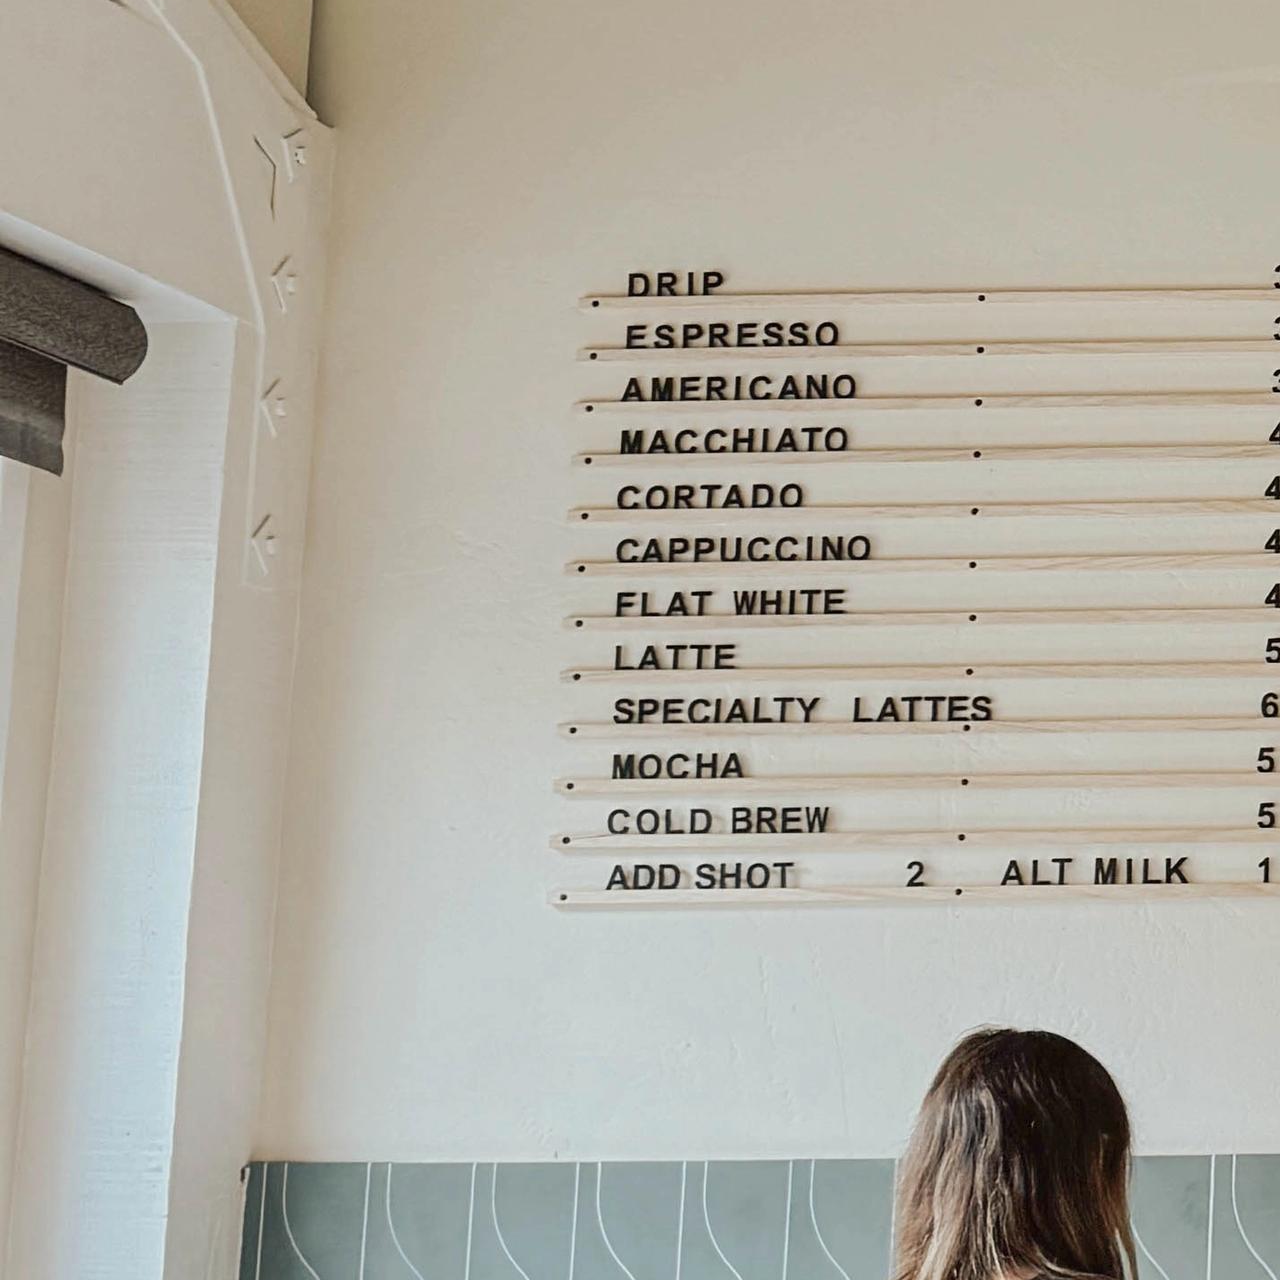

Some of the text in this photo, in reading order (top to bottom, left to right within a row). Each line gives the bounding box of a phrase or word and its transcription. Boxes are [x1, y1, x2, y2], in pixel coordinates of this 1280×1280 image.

[627, 271, 724, 298] DRIP
[624, 321, 839, 350] ESPRESSO
[619, 374, 857, 403] AMERICANO
[619, 427, 848, 455] MACCHIATO
[617, 483, 803, 510] CORTADO
[616, 535, 871, 564] CAPPUCCINO
[615, 590, 713, 618] FLAT
[733, 589, 849, 616] WHITE
[614, 644, 737, 671] LATTE
[613, 692, 1279, 725] SPECIALTY LATTES 6
[612, 747, 1275, 780] MOCHA 5
[607, 802, 1276, 835] COLD BREW 5
[606, 856, 1270, 891] ADD SHOT 2 ALT MILK 1
